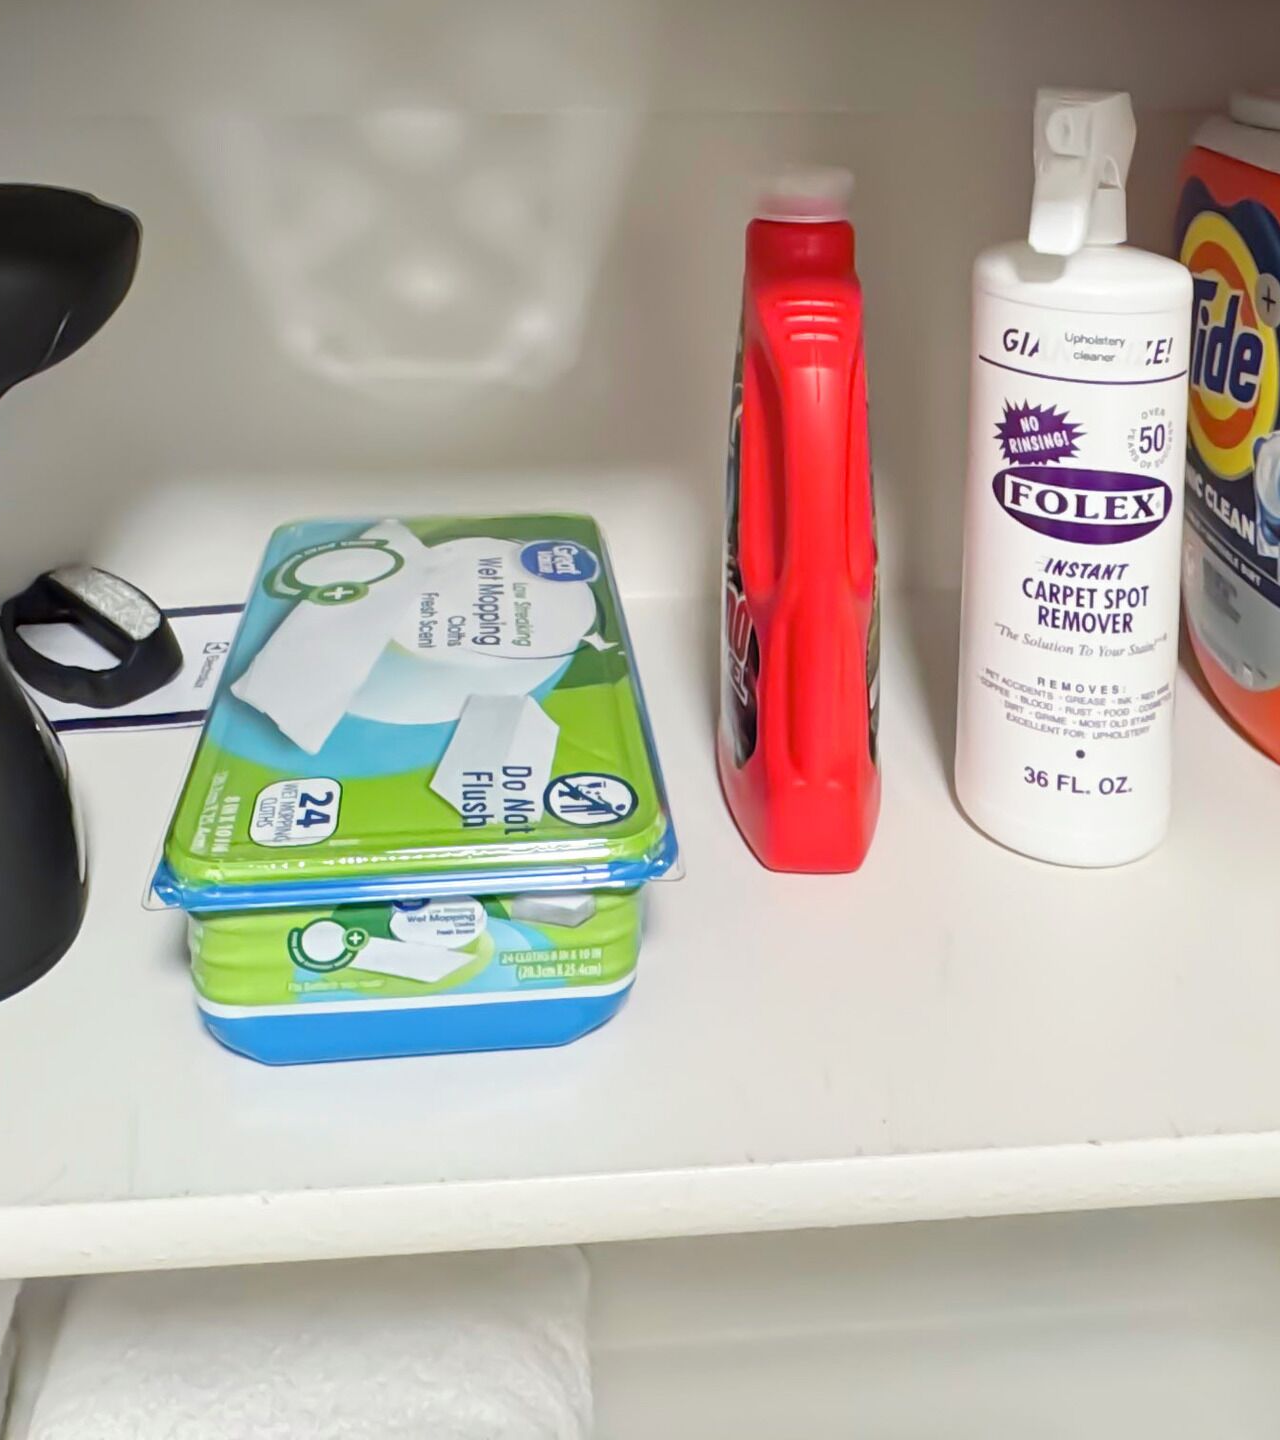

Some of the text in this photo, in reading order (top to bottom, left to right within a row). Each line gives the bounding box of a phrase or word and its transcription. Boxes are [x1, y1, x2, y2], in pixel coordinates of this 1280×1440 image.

[1064, 331, 1126, 348] Upholstery
[1191, 273, 1264, 411] Tide
[1073, 351, 1116, 362] cleaner
[1020, 415, 1040, 433] NO
[1139, 423, 1165, 454] 50
[1009, 430, 1070, 454] RINSING!
[1010, 480, 1155, 520] FOLEX
[1204, 483, 1256, 546] CLEAN
[552, 545, 581, 575] Great
[1044, 558, 1130, 581] INSTANT
[472, 556, 507, 647] Wet Mopping
[1022, 577, 1149, 610] CARPET SPOT
[418, 591, 440, 649] Fresh Scent
[512, 582, 535, 647] Low Streaking
[1037, 604, 1134, 635] REMOVER
[447, 615, 466, 648] Cloths
[1022, 632, 1074, 656] Solution
[1079, 643, 1094, 657] To
[1098, 645, 1126, 658] Your
[1001, 677, 1055, 701] ACCIDENTS
[1065, 695, 1106, 706] GREASE
[1019, 695, 1053, 711] BLOOD
[1065, 706, 1093, 716] RUST
[1103, 708, 1131, 717] FOOD
[1006, 712, 1061, 736] EXCELLENT
[1092, 725, 1151, 740] UPHOLSTERY
[1035, 711, 1067, 725] GRIME
[1078, 718, 1107, 729] MOST
[1109, 718, 1129, 729] OLD
[1024, 766, 1133, 796] 36 FL. OZ.
[256, 796, 278, 828] CLOTHS
[272, 783, 299, 843] WET MOPPING
[296, 791, 334, 829] 24
[462, 770, 494, 829] Flush
[502, 766, 535, 836] Do Not
[407, 912, 476, 923] Wet Mopping
